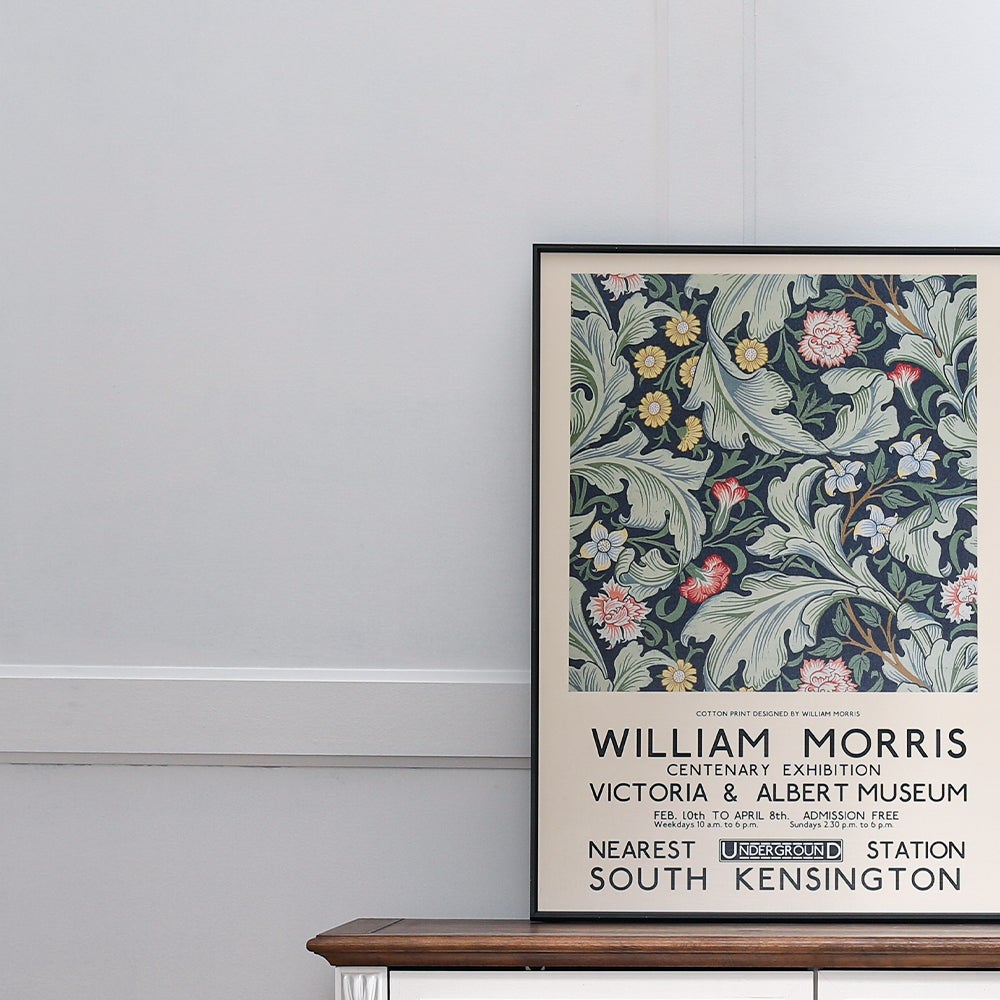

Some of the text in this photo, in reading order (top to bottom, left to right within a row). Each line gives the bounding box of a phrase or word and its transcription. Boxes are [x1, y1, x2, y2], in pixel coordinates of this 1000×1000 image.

[591, 728, 967, 758] WILLIAM MORRIS
[666, 763, 881, 777] CENTENARY EXHIBITION
[589, 783, 968, 802] VICTORIA & ALBERT MUSEUM
[654, 811, 899, 820] FEB. 10th TO APRIL 8th. ADMISSION FREE
[654, 821, 695, 830] Weekdays
[743, 822, 758, 830] p.m.
[790, 821, 822, 830] Sundays
[842, 822, 857, 830] p.m.
[589, 841, 965, 859] NEAREST UNDERGROUND STATION
[589, 867, 961, 891] SOUTH KENSINGTON
